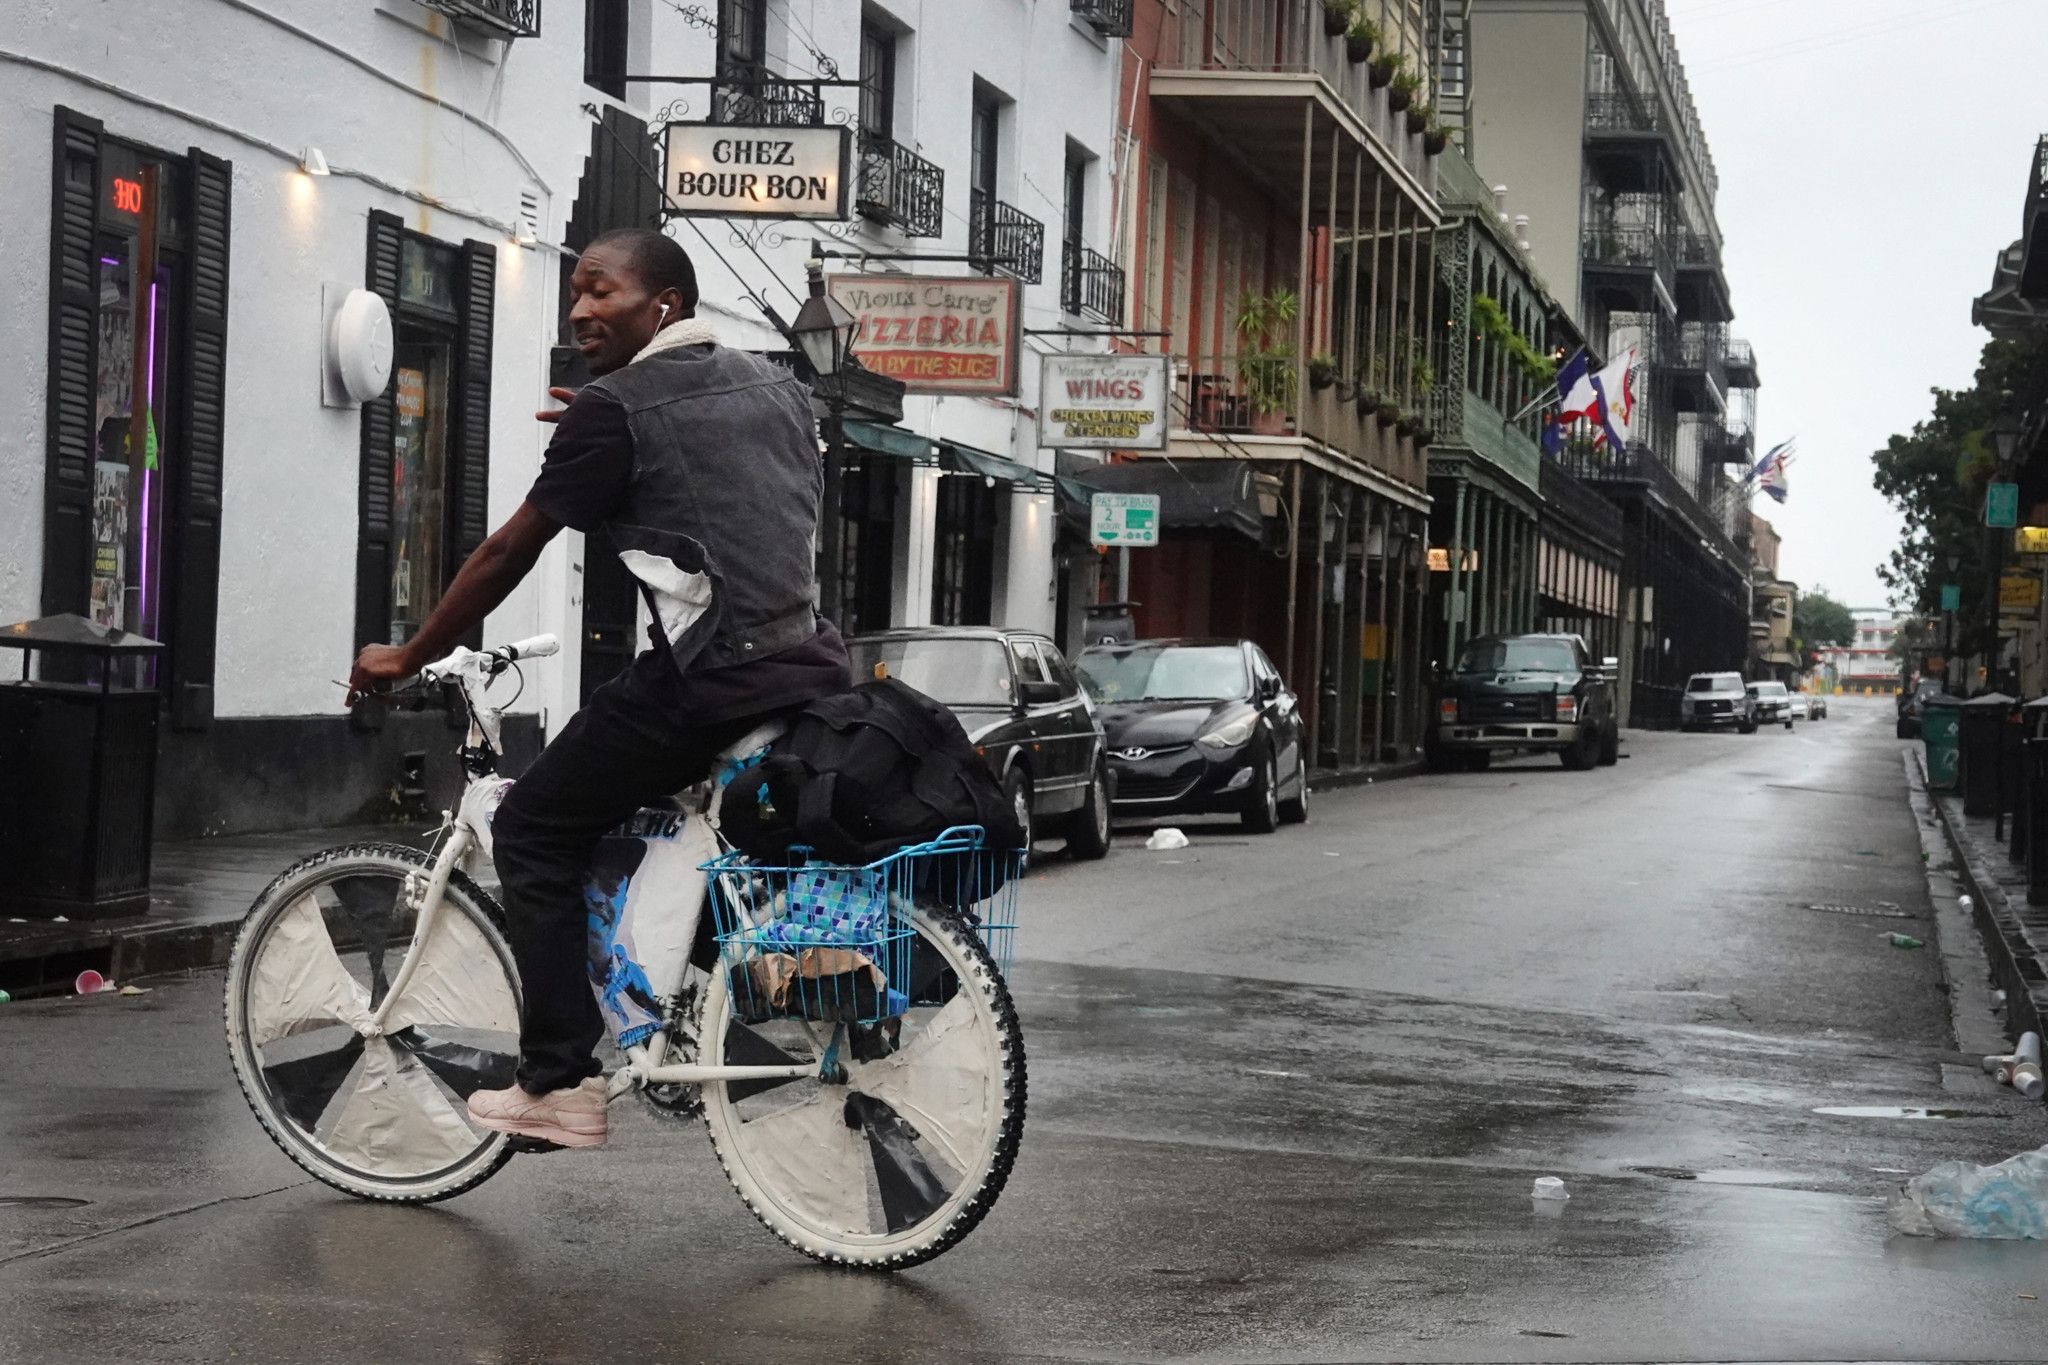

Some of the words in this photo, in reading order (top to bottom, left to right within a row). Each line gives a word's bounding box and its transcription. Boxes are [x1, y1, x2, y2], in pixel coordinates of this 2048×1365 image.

[713, 139, 795, 166] CHEZ
[857, 313, 1003, 347] IZZERIA
[887, 356, 913, 374] BY
[913, 355, 944, 375] THE
[947, 357, 993, 377] SLICE
[1065, 378, 1144, 401] WINGS
[1050, 409, 1109, 423] CHICKEN
[1111, 410, 1155, 424] WINGS
[1096, 495, 1113, 507] PAY
[1115, 495, 1127, 507] TO
[1130, 496, 1153, 508] PARK
[1105, 508, 1113, 521] 2
